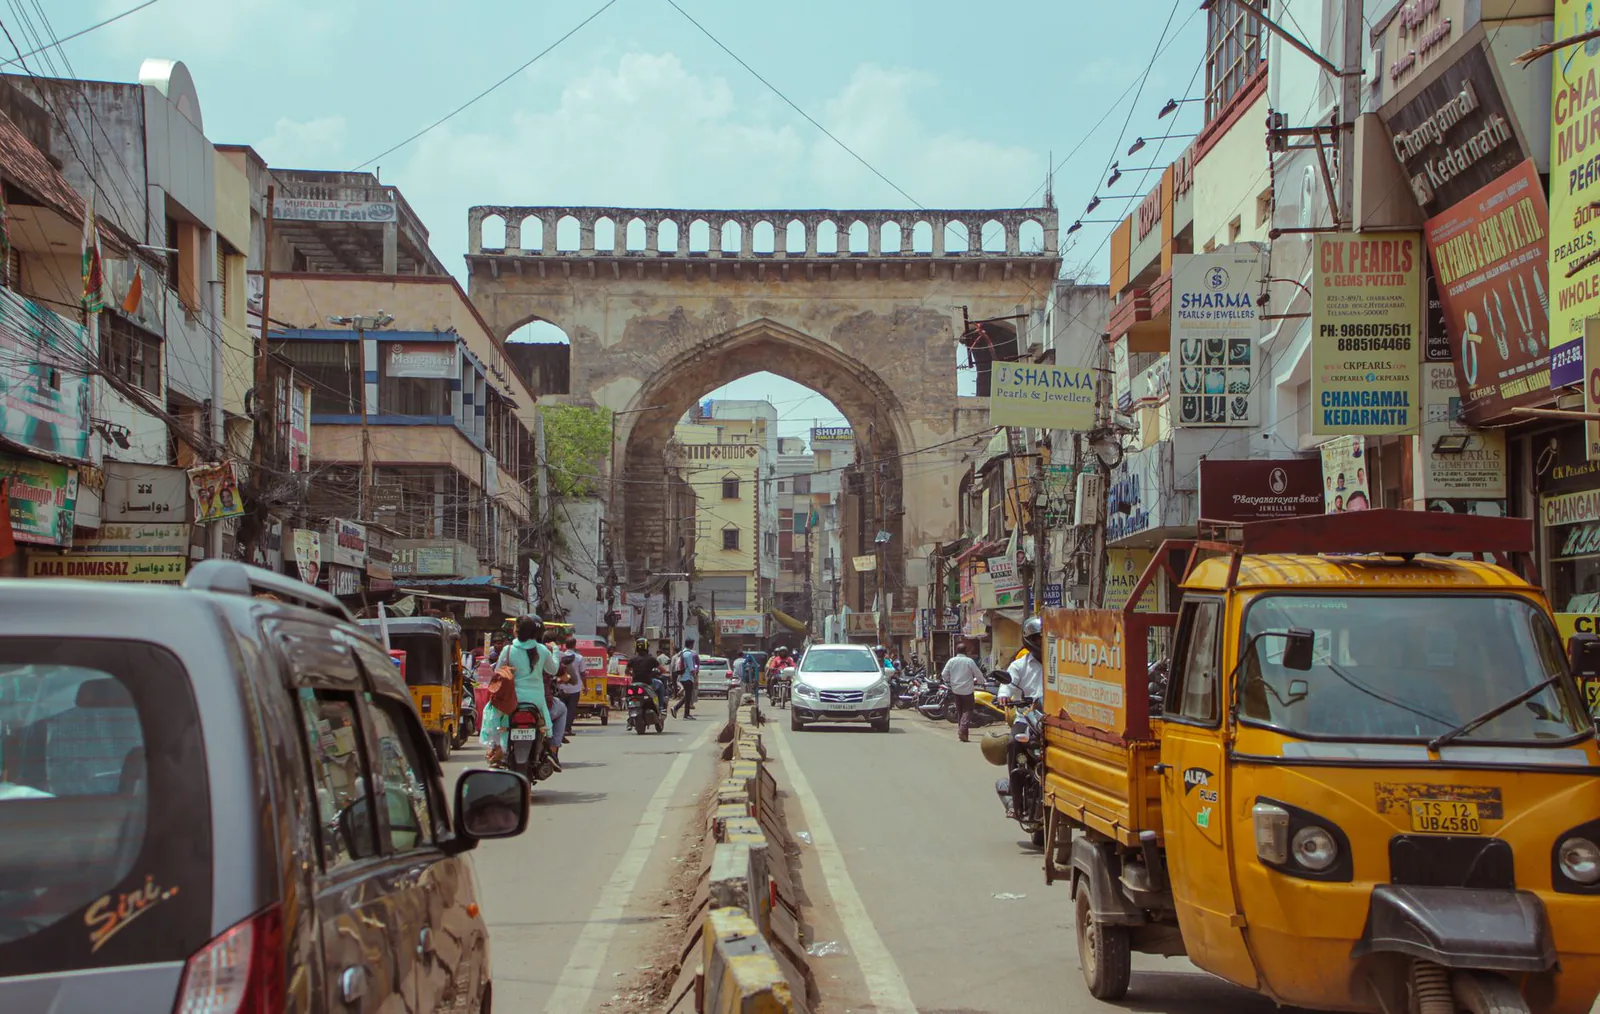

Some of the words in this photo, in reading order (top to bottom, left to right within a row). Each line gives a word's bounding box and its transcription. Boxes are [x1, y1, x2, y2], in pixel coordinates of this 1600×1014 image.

[1424, 112, 1512, 189] Kedarnath
[284, 199, 341, 209] MURARILAL
[1320, 241, 1344, 273] CK
[1349, 240, 1413, 274] PEARLS
[1324, 276, 1331, 287] &
[1335, 275, 1363, 287] GEMS
[1181, 292, 1252, 309] SHARMA
[1178, 310, 1205, 319] PEARLS
[1213, 310, 1255, 320] JEWELLERS
[1320, 325, 1338, 337] PH:
[1341, 324, 1411, 337] 9866075611
[1338, 338, 1411, 351] 8885164466
[1013, 367, 1093, 391] SHARMA
[1431, 367, 1456, 379] CHA
[997, 387, 1027, 399] Pearls
[1030, 390, 1040, 400] &
[1042, 390, 1092, 404] Jewellers
[1321, 390, 1410, 407] CHANGAMAL
[1324, 409, 1407, 426] KEDARNATH
[1299, 493, 1319, 503] Sons
[33, 561, 63, 576] LALA
[66, 562, 128, 576] DAWASAZ
[1184, 770, 1208, 786] ALFA
[1199, 789, 1217, 803] PLUS
[1422, 802, 1441, 816] TS
[1452, 803, 1469, 817] 12
[1420, 816, 1478, 832] UB4580
